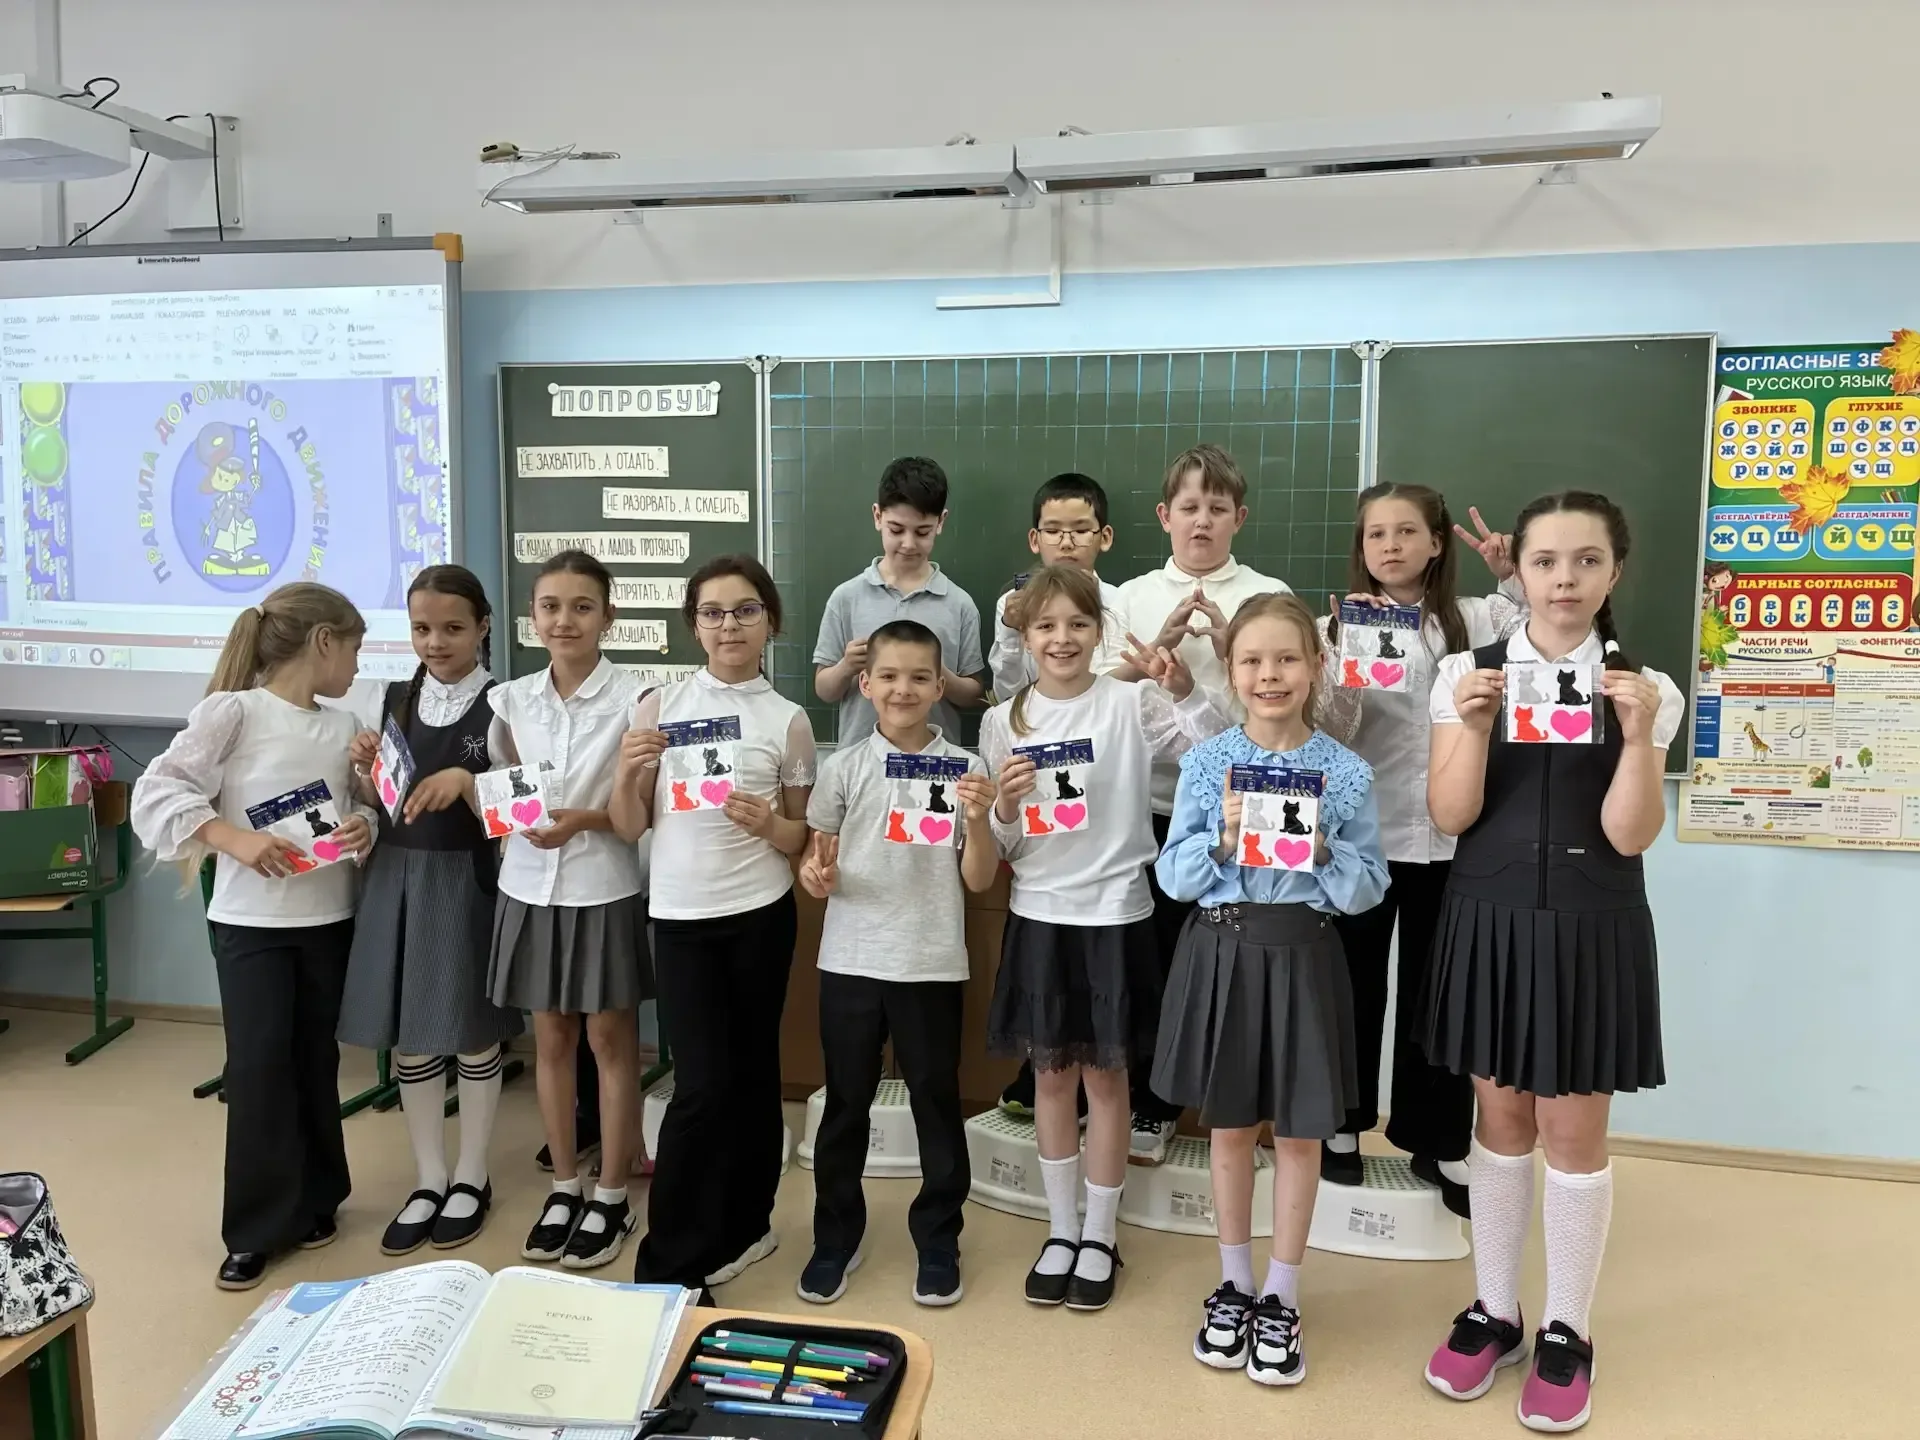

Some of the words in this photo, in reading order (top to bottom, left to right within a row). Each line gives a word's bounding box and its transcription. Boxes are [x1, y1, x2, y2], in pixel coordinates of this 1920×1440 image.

[1721, 352, 1851, 371] СОГЛАСНЫЕ
[1746, 375, 1835, 391] РУССКОГО
[559, 386, 711, 412] ПОПРОБУЙ
[1732, 405, 1797, 415] ЗВОНКИЕ
[1848, 402, 1903, 412] ГЛУХИЕ
[1722, 422, 1735, 437] б
[1747, 425, 1758, 434] в
[1770, 424, 1780, 434] г
[1792, 421, 1807, 434] д
[1833, 422, 1846, 432] п
[1856, 419, 1869, 433] ф
[1880, 421, 1892, 431] к
[1904, 421, 1916, 431] т
[1720, 444, 1735, 455] ж
[1768, 442, 1782, 455] й
[1791, 443, 1805, 454] л
[1830, 443, 1846, 453] ш
[1855, 442, 1867, 452] с
[1878, 442, 1891, 452] х
[1902, 441, 1915, 453] ц
[520, 453, 533, 471] НЕ
[536, 452, 601, 471] ЗАХВАТИТЬ,
[604, 452, 612, 470] А
[1735, 464, 1747, 478] р
[1756, 465, 1769, 475] н
[1778, 464, 1794, 475] м
[1854, 464, 1867, 474] ч
[1876, 463, 1891, 475] щ
[137, 451, 172, 584] ПРАВИЛА
[155, 380, 288, 446] ДОРОЖНОГО
[607, 493, 618, 511] НЕ
[623, 495, 682, 513] РАЗОРВАТЬ,
[684, 496, 691, 512] А
[1714, 513, 1750, 521] ВСЕГДА
[1830, 527, 1845, 544] й
[516, 538, 525, 556] НЕ
[600, 539, 605, 556] А
[607, 538, 636, 556] ЛАДОНЬ
[1737, 580, 1800, 589] ПАРНЫЕ
[1805, 579, 1898, 589] СОГЛАСНЫЕ
[667, 584, 674, 600] А
[1764, 612, 1778, 625] ф
[521, 622, 532, 640] НЕ
[1741, 638, 1777, 646] ЧАСТИ
[1780, 638, 1808, 646] РЕЧИ
[1738, 647, 1782, 655] РУССКОГО
[1783, 647, 1813, 655] ЯЗЫКА
